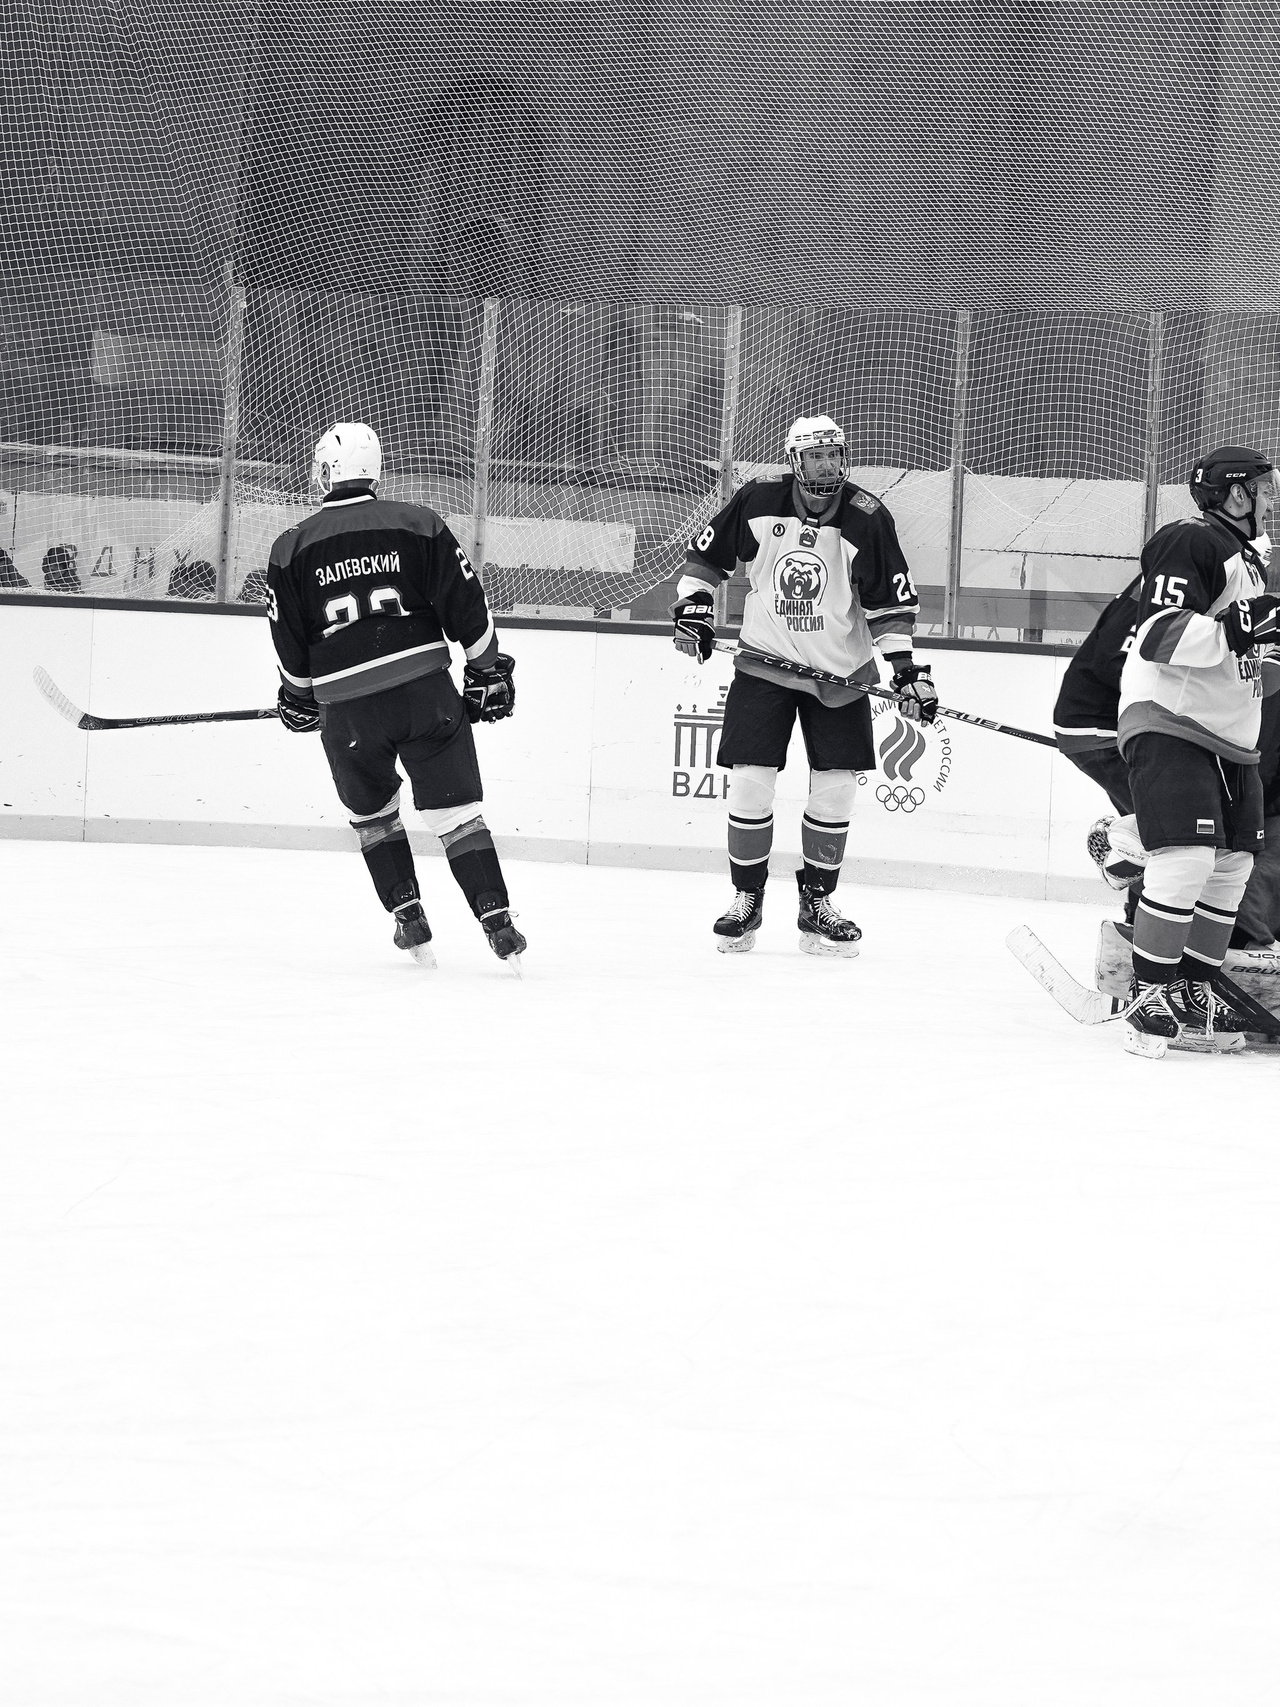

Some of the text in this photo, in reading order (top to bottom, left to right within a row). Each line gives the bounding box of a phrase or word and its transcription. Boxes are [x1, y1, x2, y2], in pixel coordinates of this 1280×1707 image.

[1195, 468, 1204, 483] 3
[695, 525, 715, 552] 8
[315, 551, 401, 587] ЗАЛЕВСКИЙ
[1150, 574, 1188, 608] 15
[774, 599, 814, 618] ЕДИНАЯ
[786, 615, 825, 632] РОССИЯ
[933, 737, 952, 793] РОССИИ
[672, 771, 731, 800] ВДН
